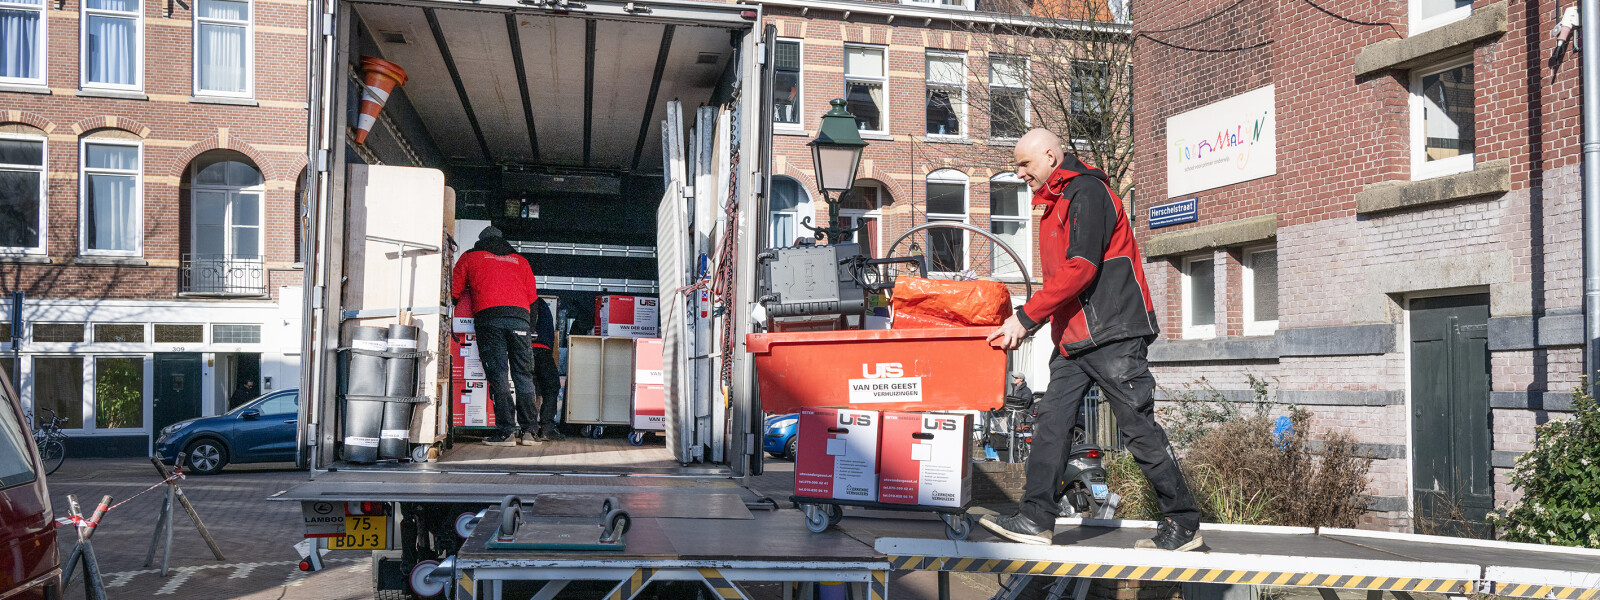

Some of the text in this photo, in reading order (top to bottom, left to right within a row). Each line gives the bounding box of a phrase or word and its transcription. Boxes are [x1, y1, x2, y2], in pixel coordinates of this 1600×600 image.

[1151, 202, 1193, 217] Herschelstraat
[639, 299, 656, 307] UTS
[862, 362, 904, 378] UTS
[840, 413, 871, 426] UTS
[925, 418, 956, 431] UTS
[336, 534, 379, 547] BDJ-3
